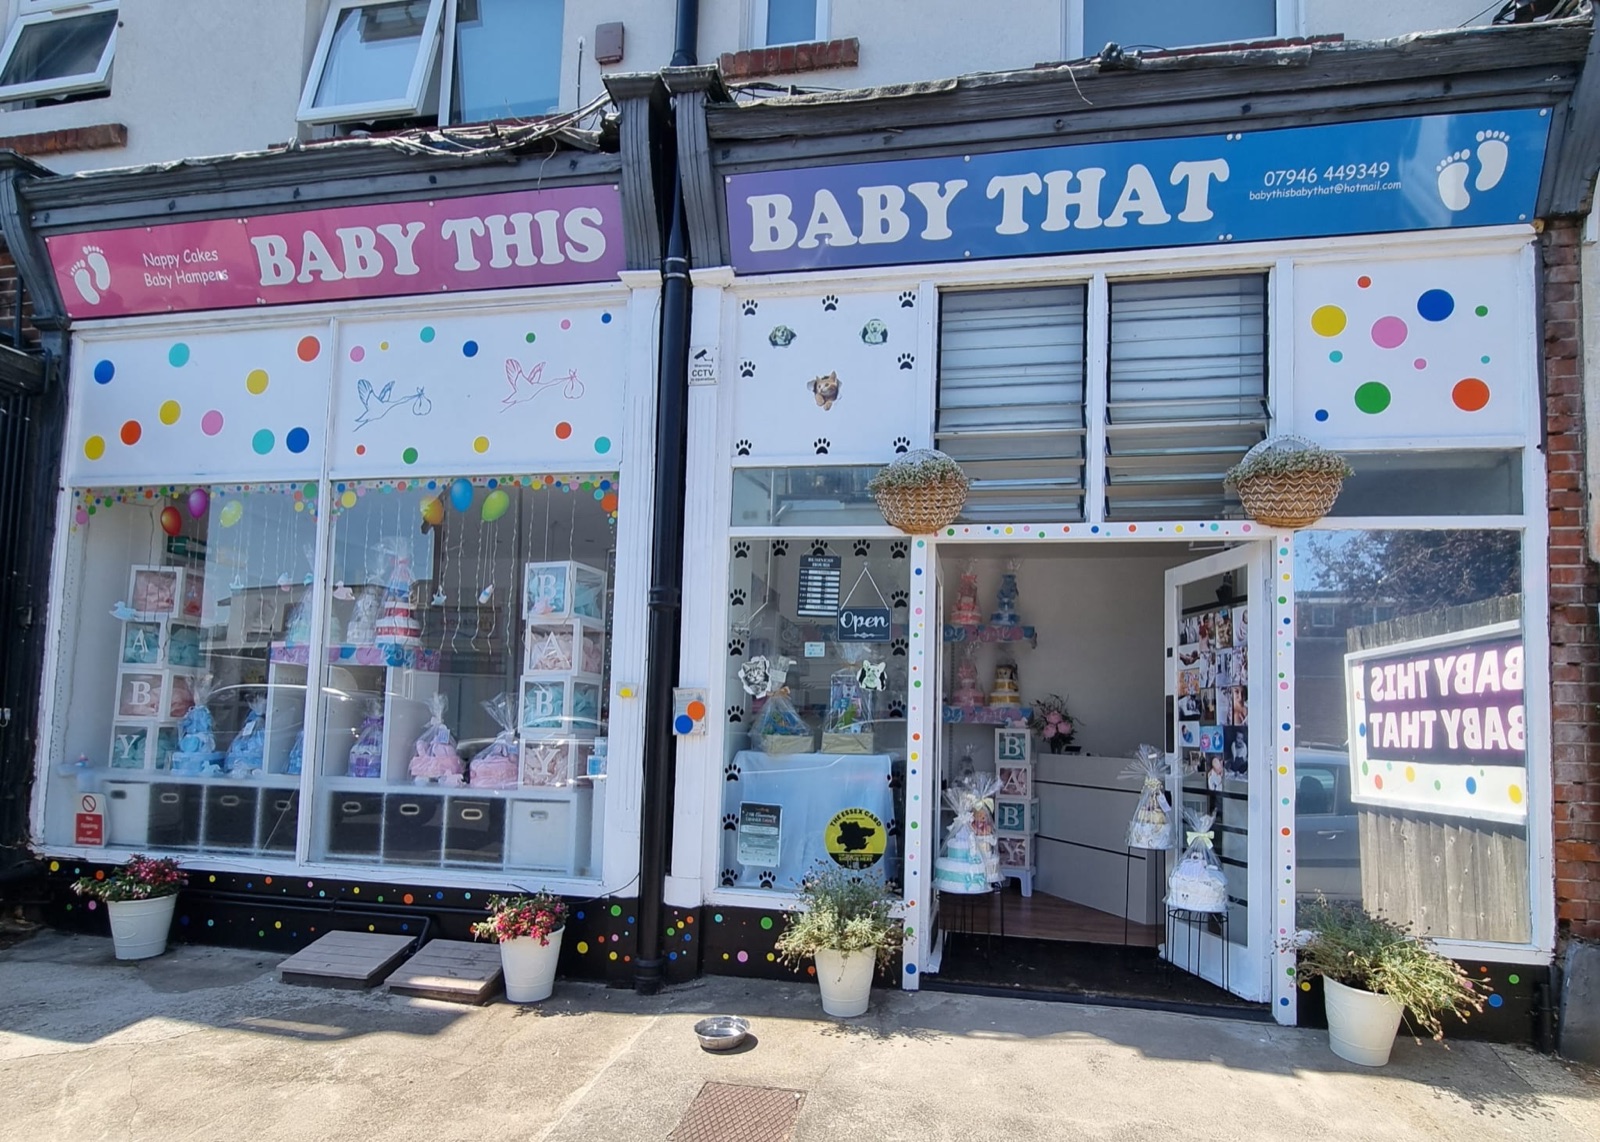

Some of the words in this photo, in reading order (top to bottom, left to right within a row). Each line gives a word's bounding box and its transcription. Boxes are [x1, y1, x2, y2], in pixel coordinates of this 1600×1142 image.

[1264, 167, 1318, 187] 07946
[1323, 161, 1390, 181] 449349
[1249, 180, 1402, 201] babythisbabythat@hotmail.com
[746, 179, 968, 252] BABY
[986, 158, 1230, 235] THAT
[251, 221, 425, 286] BABY
[441, 207, 606, 271] THIS
[142, 252, 180, 269] Nappy
[183, 247, 219, 263] Cakes
[143, 271, 172, 289] Baby
[691, 369, 714, 377] CCTV
[840, 611, 889, 633] Open
[830, 814, 842, 827] THE
[841, 808, 863, 817] ESSEX
[864, 811, 882, 827] CARD
